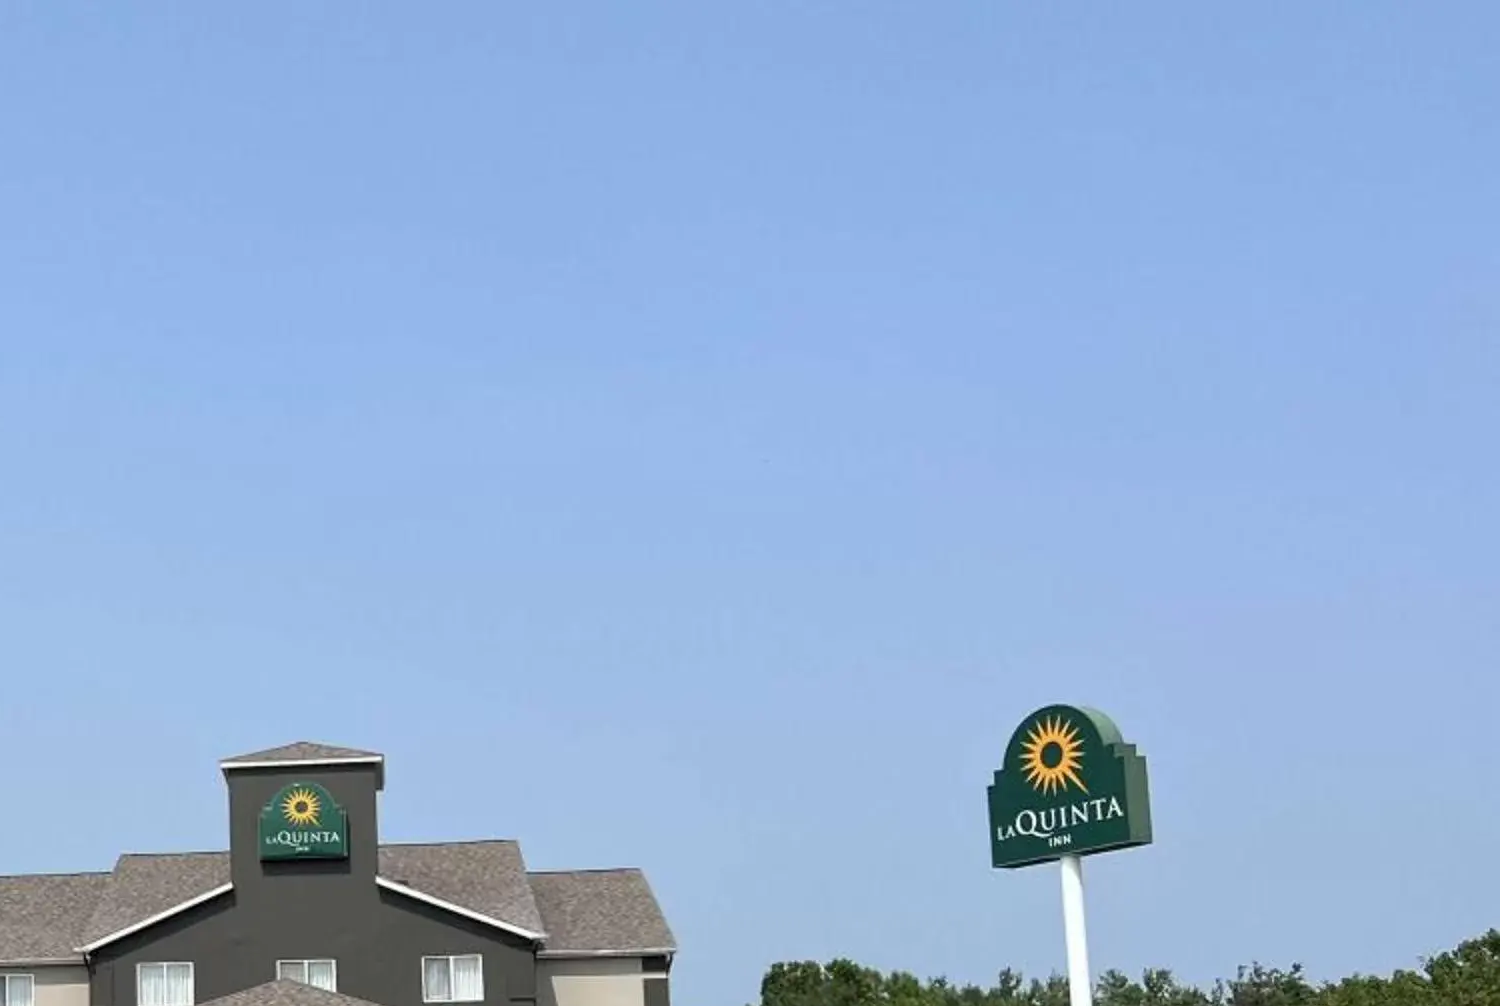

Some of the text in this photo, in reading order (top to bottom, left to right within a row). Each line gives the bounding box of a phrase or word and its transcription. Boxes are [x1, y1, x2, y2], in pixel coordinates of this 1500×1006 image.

[1015, 796, 1123, 838] QUINTA
[277, 830, 340, 847] QUINTA
[1049, 834, 1072, 848] INN
